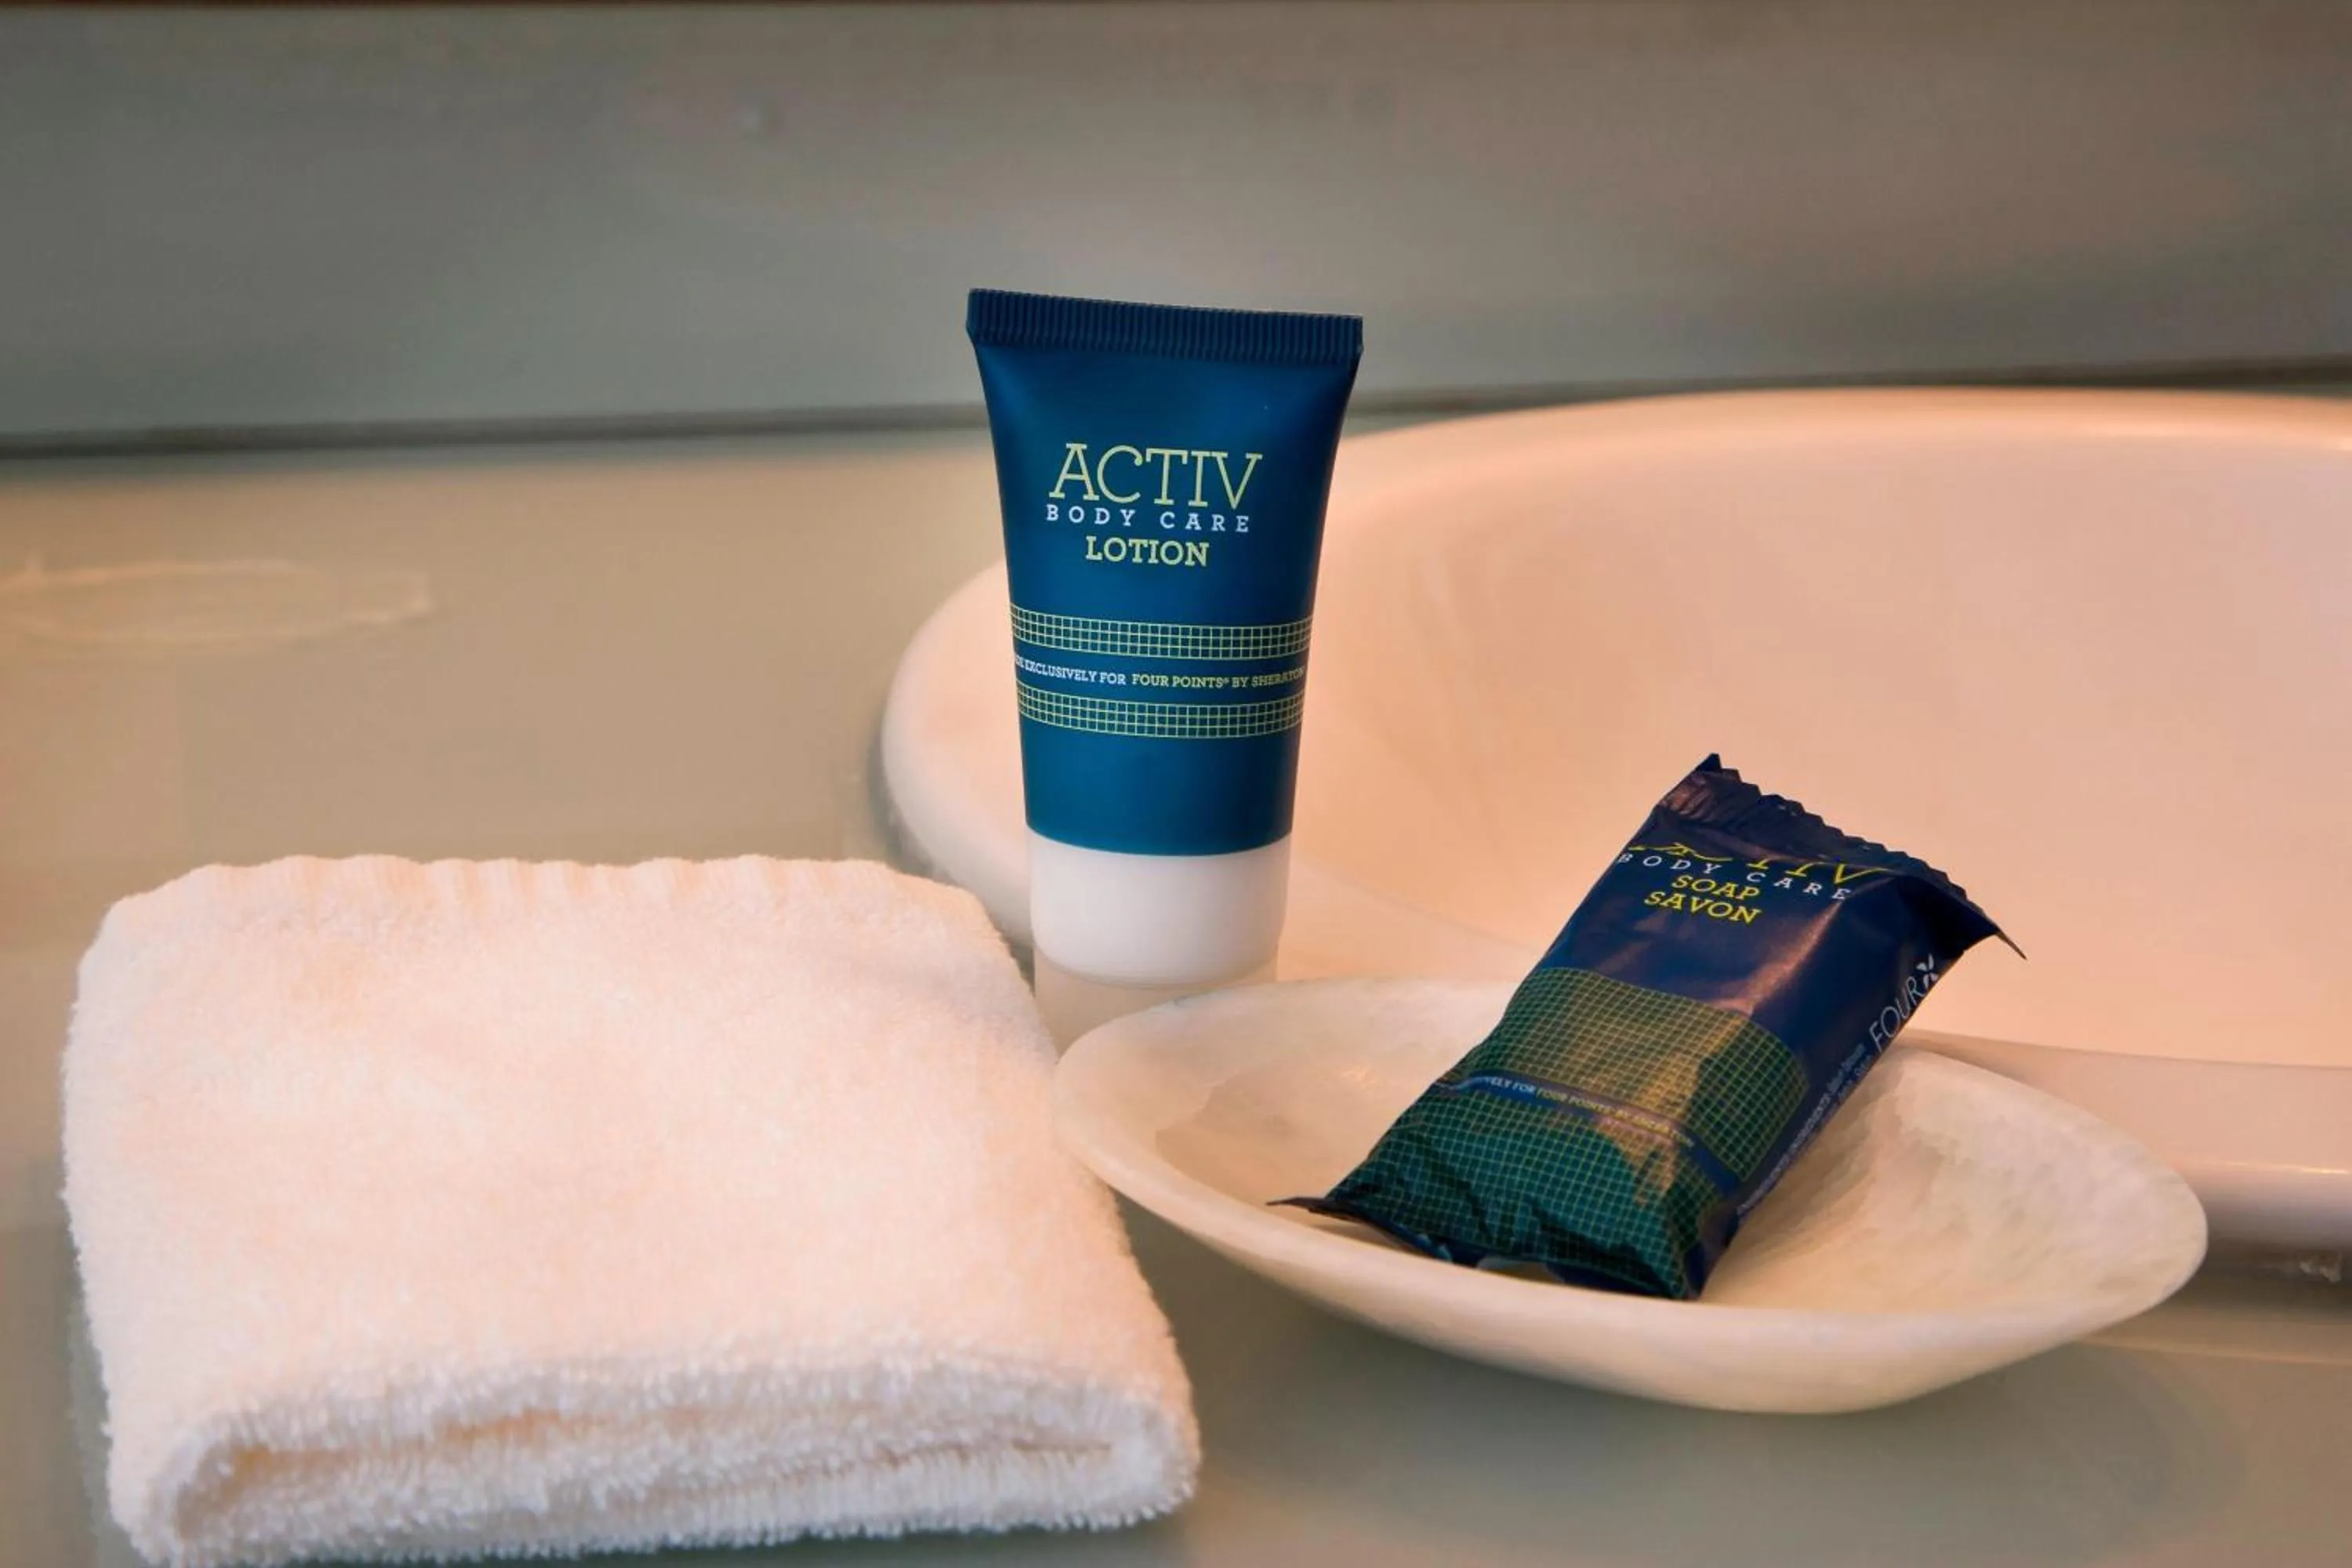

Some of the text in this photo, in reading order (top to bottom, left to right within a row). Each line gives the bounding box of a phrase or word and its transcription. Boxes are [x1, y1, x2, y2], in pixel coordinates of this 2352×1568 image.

[1048, 443, 1263, 510] ACTIV
[1045, 504, 1250, 533] BODY CARE
[1085, 535, 1210, 567] LOTION
[1025, 659, 1098, 683] EXCLUSIVELY
[1099, 672, 1127, 685] FOR
[1131, 673, 1169, 687] FOUR
[1232, 677, 1250, 688] BY
[1617, 852, 1722, 875] BODY
[1746, 871, 1851, 899] CARE
[1671, 874, 1760, 900] SOAP
[1643, 891, 1762, 924] SAVON
